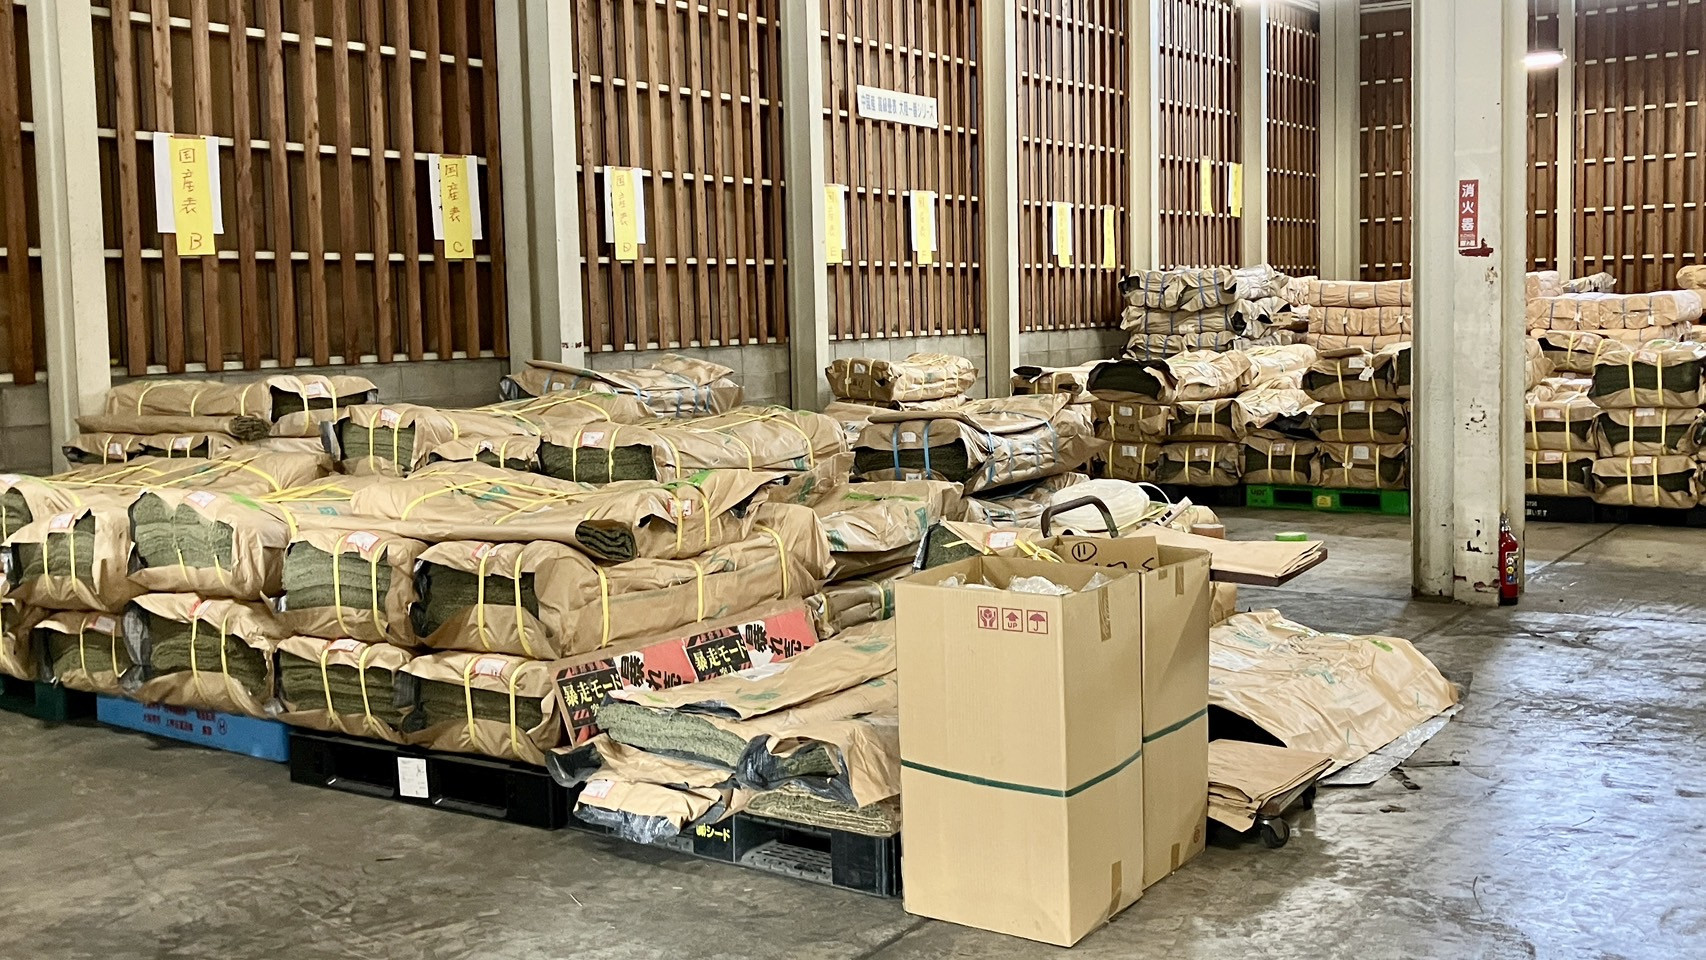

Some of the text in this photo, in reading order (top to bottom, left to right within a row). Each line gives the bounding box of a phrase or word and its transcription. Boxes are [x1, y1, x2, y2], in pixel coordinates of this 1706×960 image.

[178, 147, 203, 251] 国産表 B
[444, 163, 465, 253] 国産表 C
[1461, 183, 1475, 231] 消火器
[1007, 621, 1018, 629] UP
[693, 639, 747, 672] 暴走モード
[562, 673, 622, 707] 暴走モード
